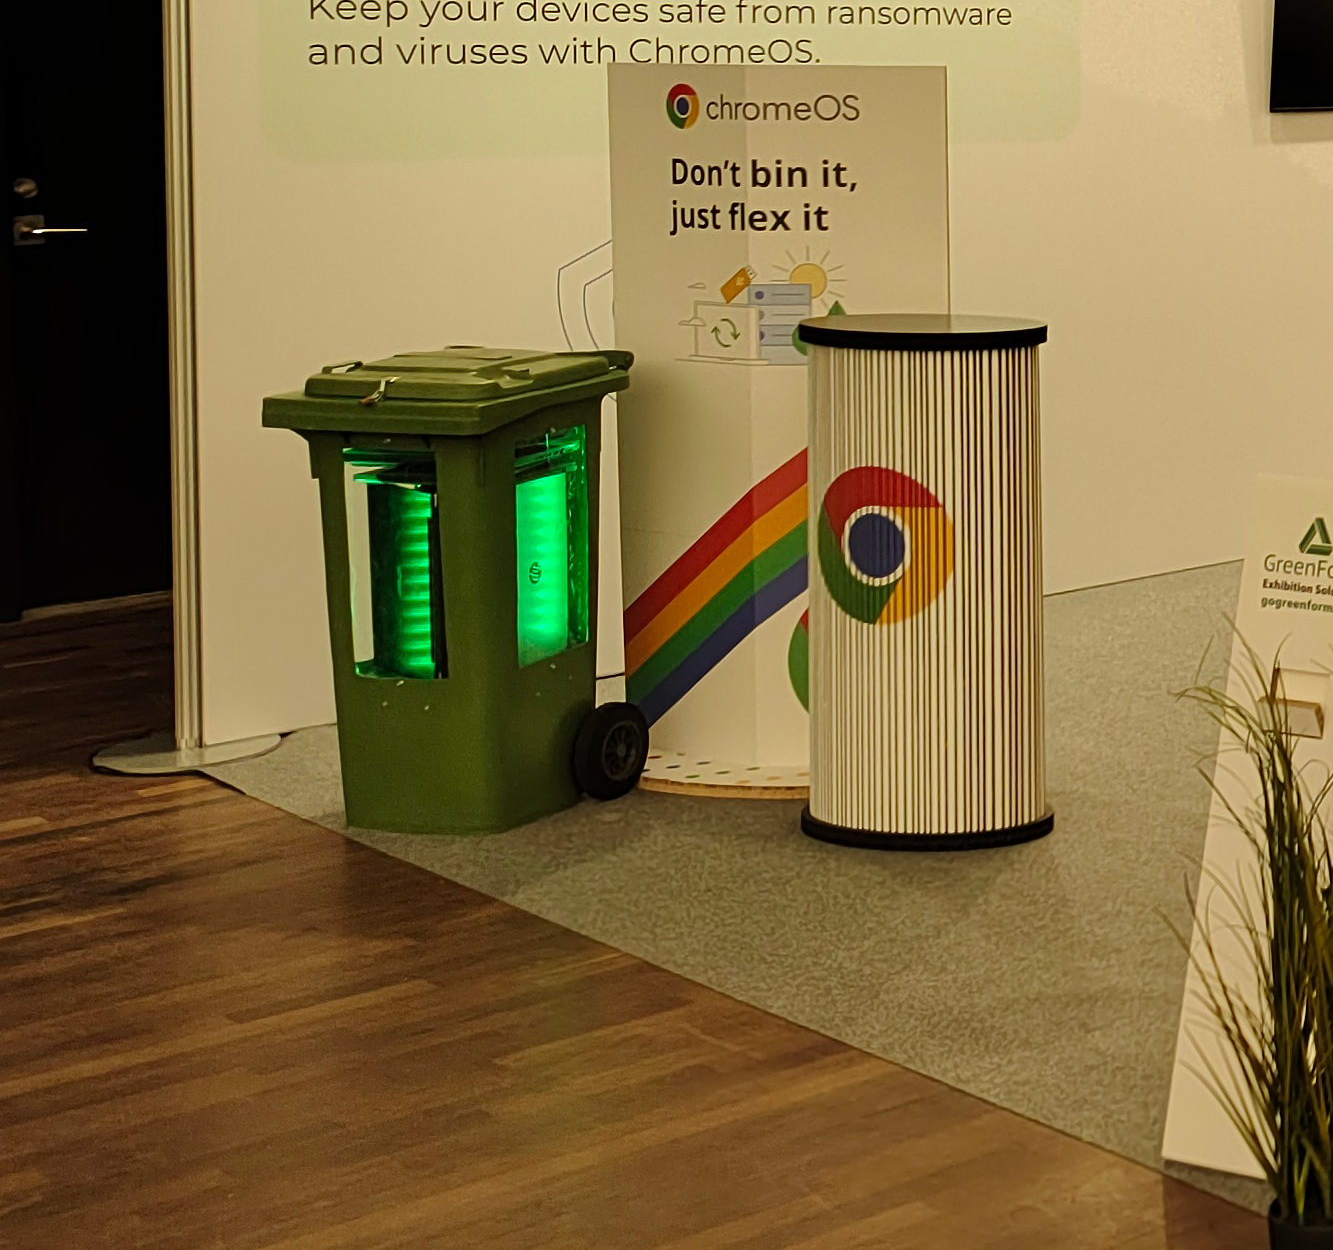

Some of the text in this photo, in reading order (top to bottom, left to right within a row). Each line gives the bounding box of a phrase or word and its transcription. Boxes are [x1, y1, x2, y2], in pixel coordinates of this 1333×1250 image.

[418, 0, 504, 28] your
[827, 2, 1012, 26] ransomware
[308, 36, 821, 65] and viruses with ChromeOS.
[706, 94, 860, 122] chromeOS
[671, 158, 858, 193] Don't bin it,
[669, 199, 829, 236] just flex it
[1262, 578, 1313, 594] Exhibition
